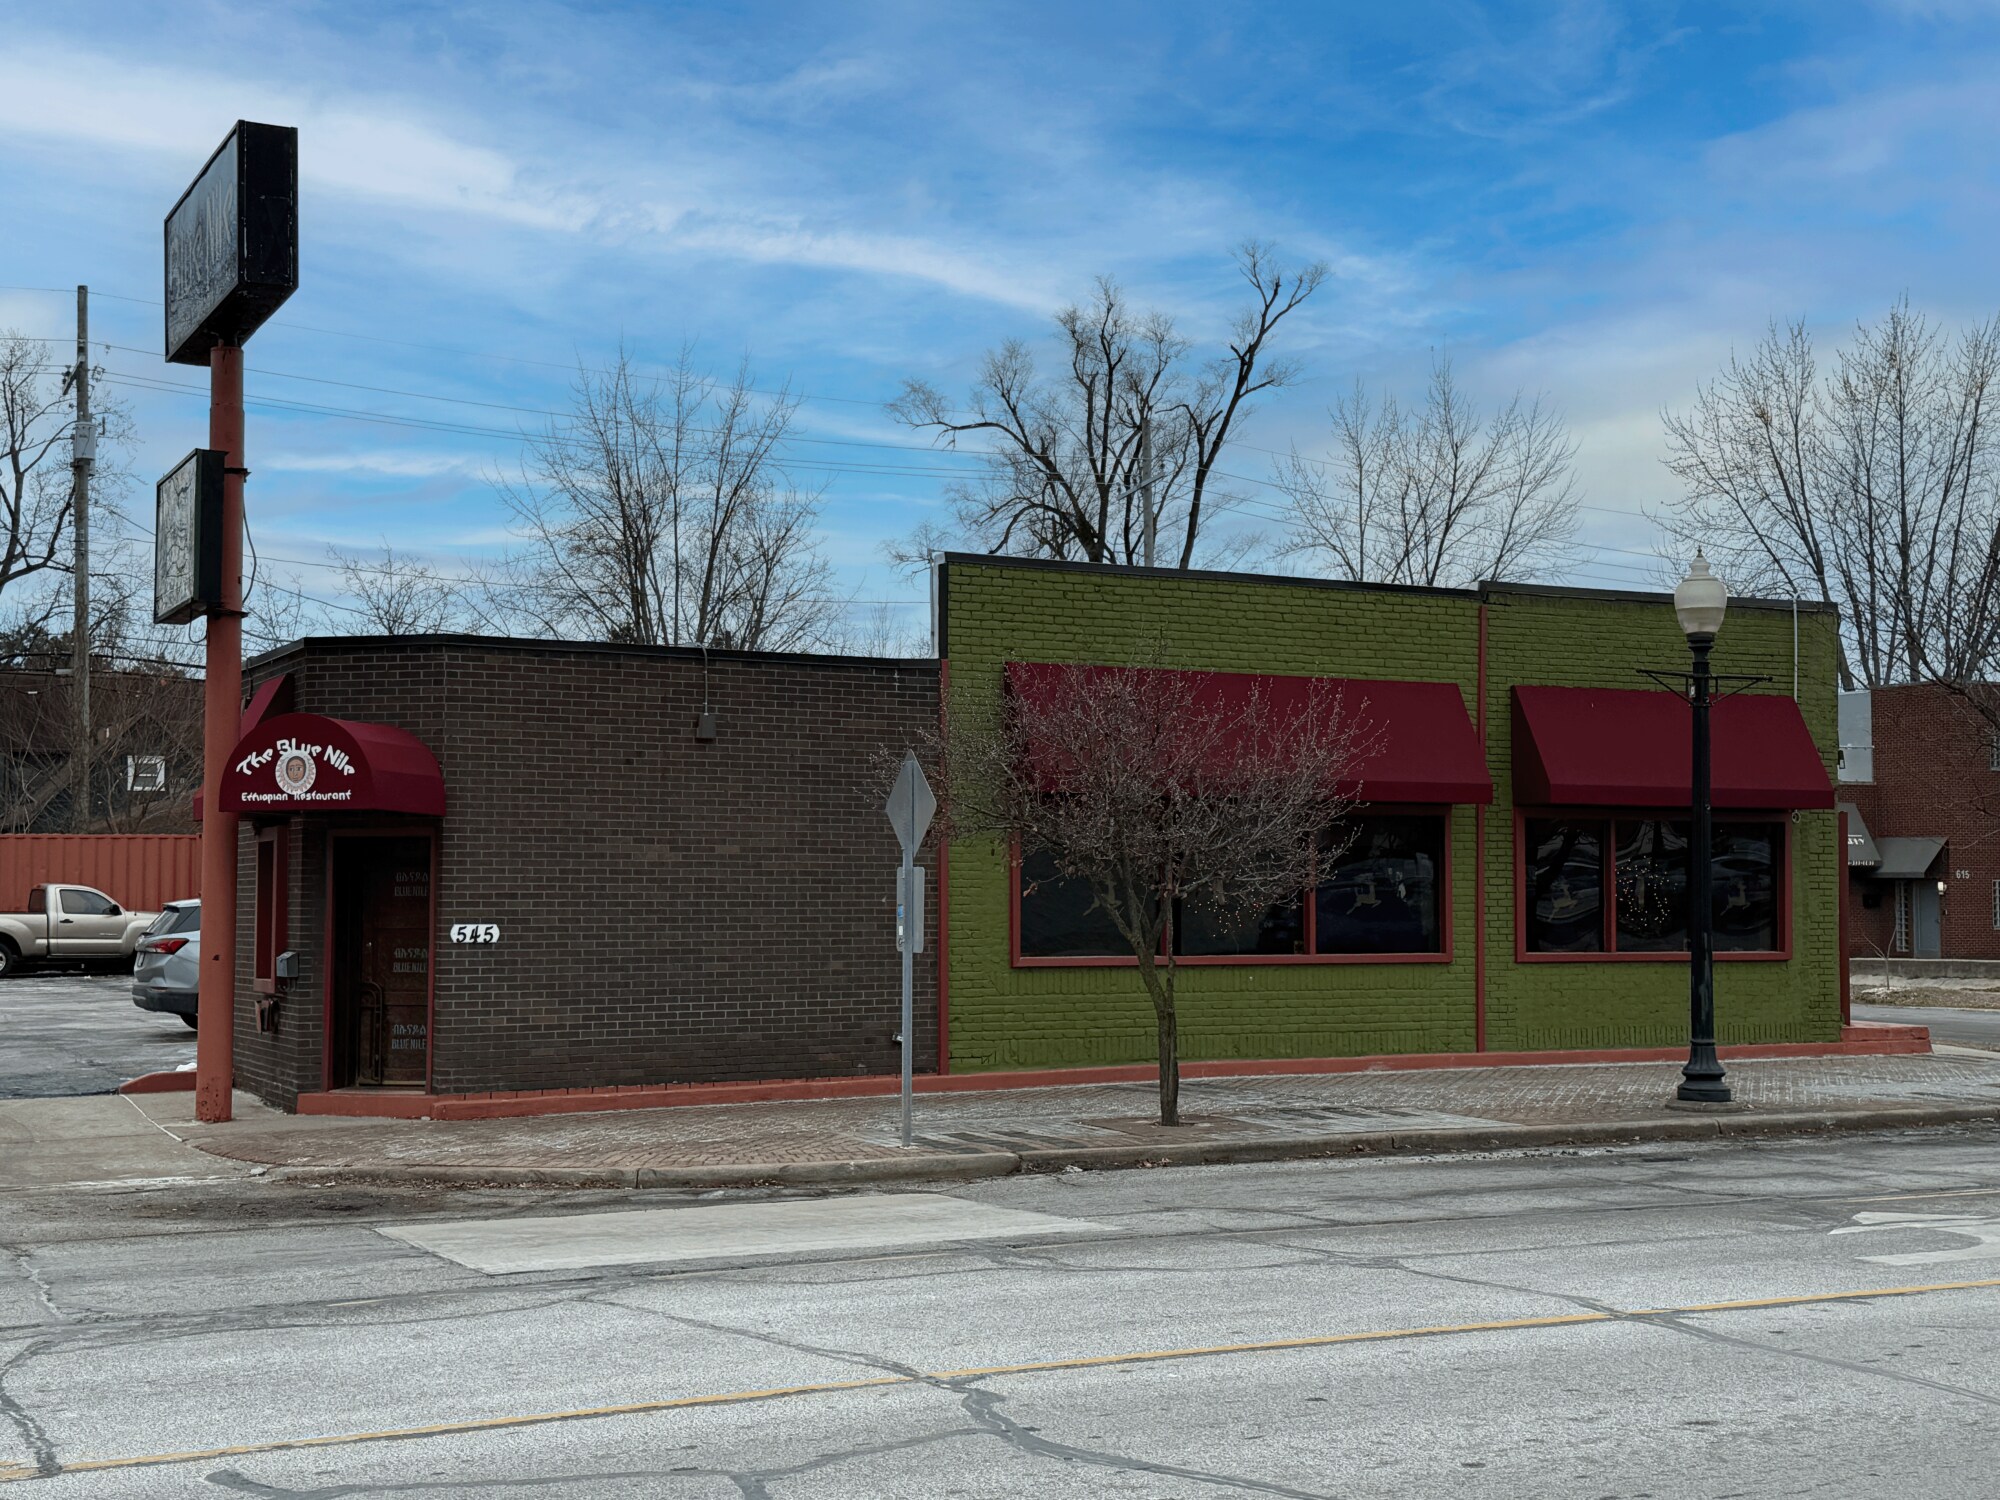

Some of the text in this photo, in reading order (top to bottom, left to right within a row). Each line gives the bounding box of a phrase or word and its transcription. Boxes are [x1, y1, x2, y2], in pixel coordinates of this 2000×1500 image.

[236, 748, 273, 776] The
[323, 744, 355, 776] Nile
[241, 789, 352, 804] Ethiopian Restaurant
[1955, 869, 1970, 879] 615
[456, 925, 494, 943] 545
